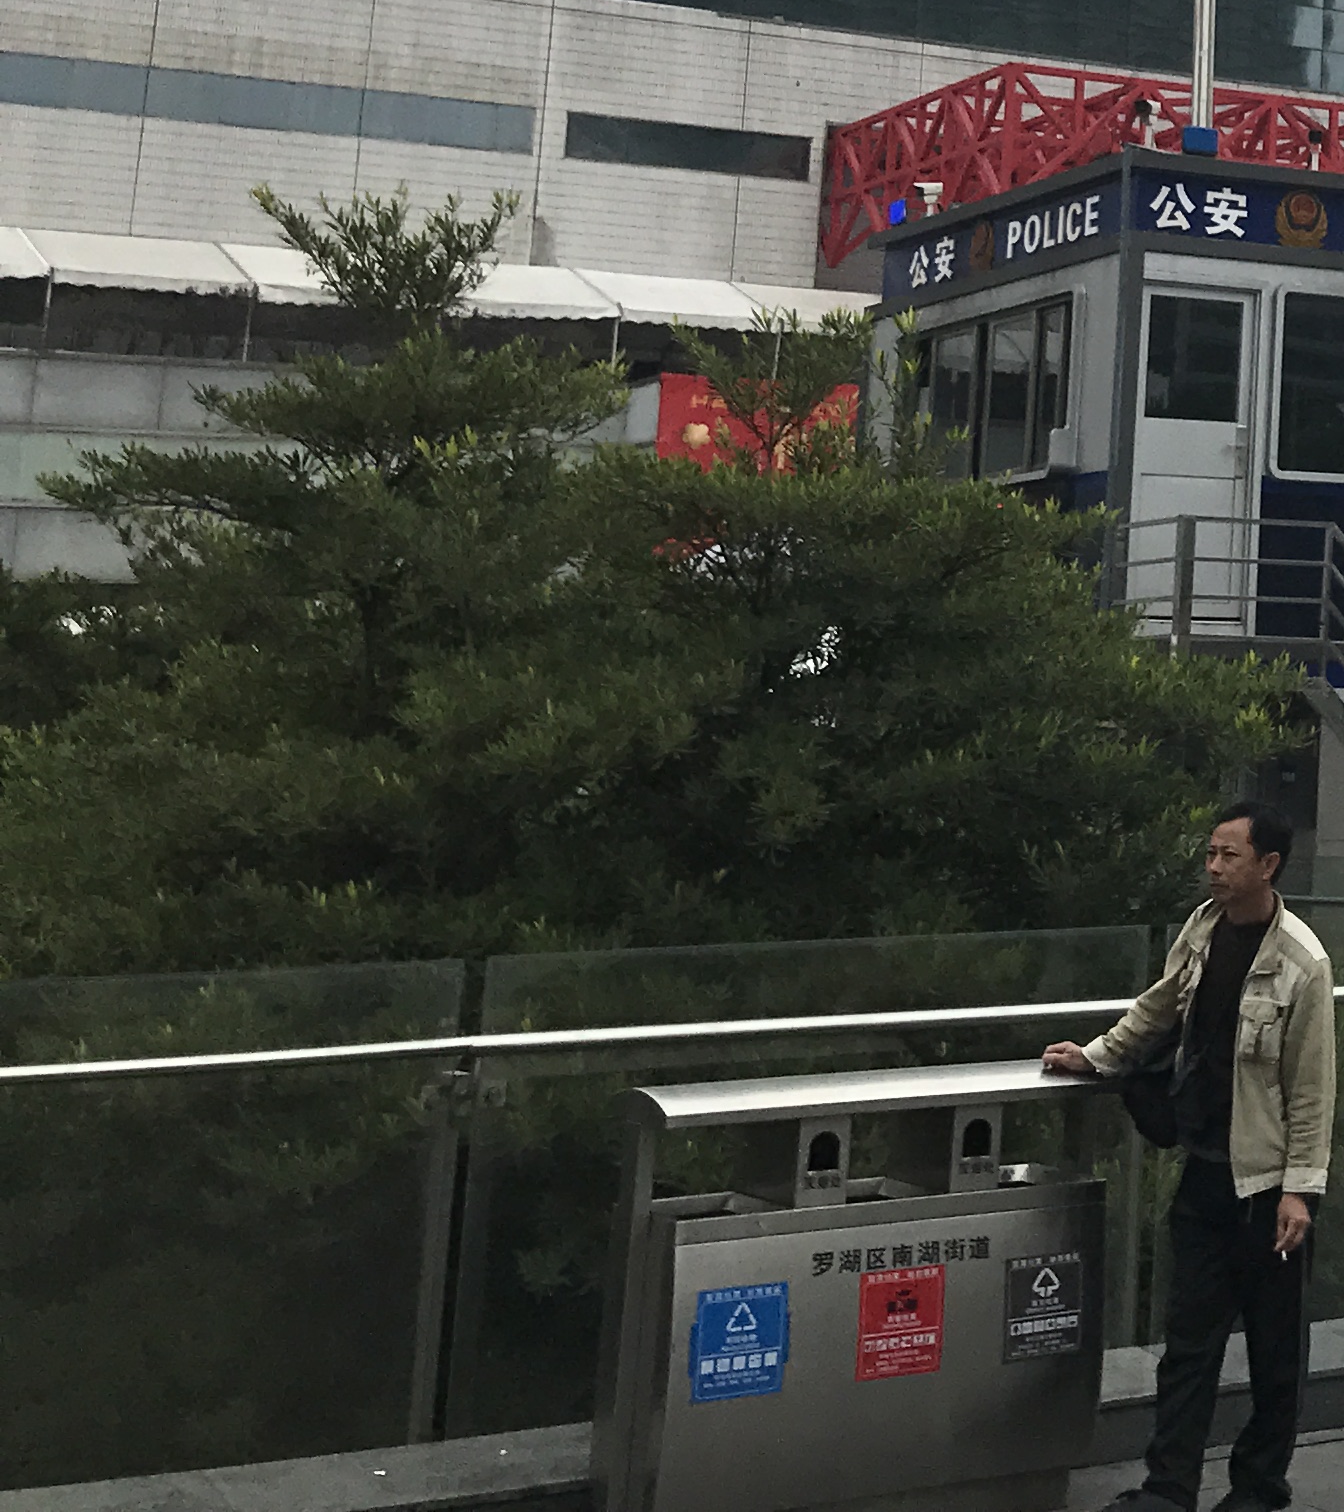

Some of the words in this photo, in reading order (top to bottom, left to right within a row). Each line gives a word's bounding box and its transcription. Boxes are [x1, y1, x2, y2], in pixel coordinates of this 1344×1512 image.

[1006, 193, 1100, 259] POLICE
[1150, 183, 1249, 238] 公安
[908, 236, 955, 288] 公安
[811, 1235, 992, 1277] 罗湖区南湖街道
